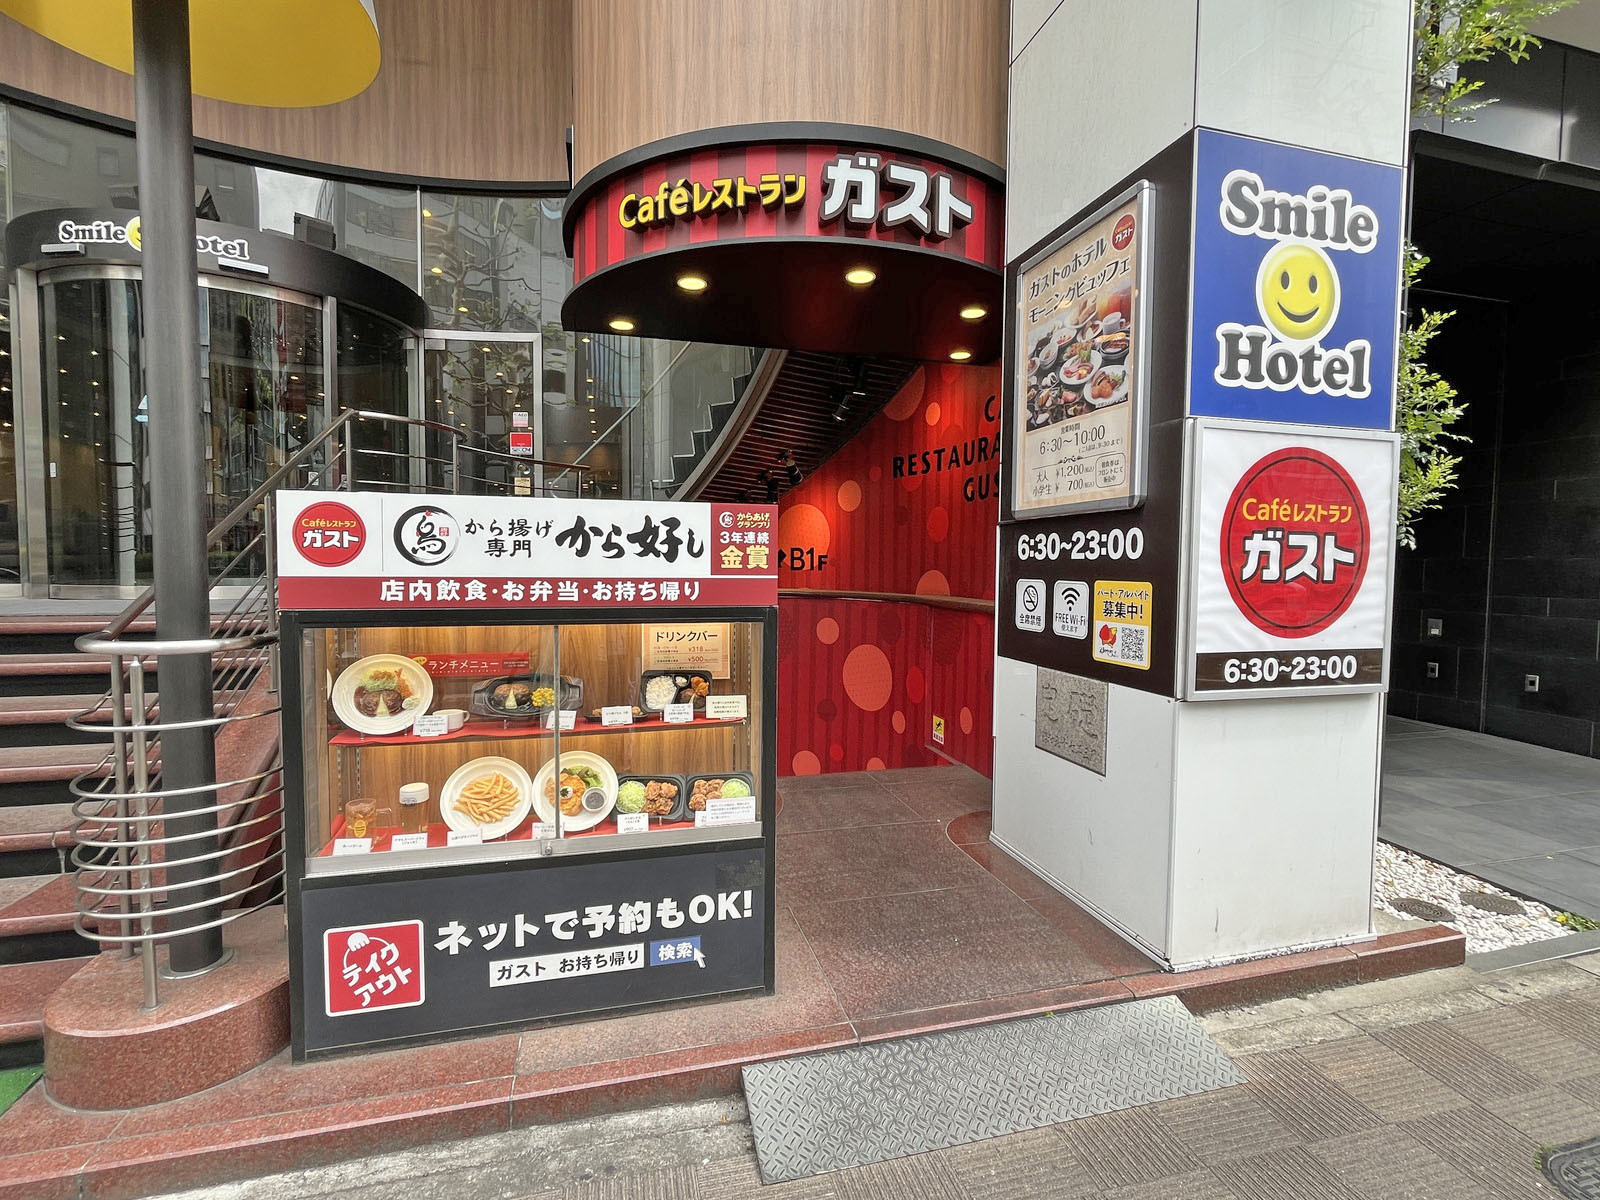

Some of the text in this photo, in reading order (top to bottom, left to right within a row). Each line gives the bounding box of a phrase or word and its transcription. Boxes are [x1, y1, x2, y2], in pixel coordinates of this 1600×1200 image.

[619, 153, 974, 236] Caféレストラン ガスト
[1222, 173, 1376, 250] Smile
[60, 221, 249, 259] Smile otel
[1114, 227, 1133, 243] ガスト
[1029, 238, 1108, 300] ガストのホテル
[1029, 257, 1130, 323] モーニングビュッフェ
[1217, 326, 1369, 396] Hotel
[1037, 471, 1048, 483] 大人
[1033, 483, 1052, 496] 小学生
[737, 512, 770, 522] からあげ
[1242, 498, 1352, 523] Caféレストラン
[302, 518, 357, 528] Caféレストラン
[464, 518, 553, 537] から揚げ
[737, 520, 771, 529] グランプリ
[302, 530, 360, 548] ガスト
[484, 538, 531, 559] 専門
[555, 515, 704, 563] から好し
[720, 532, 769, 544] 3年連続
[1017, 527, 1144, 560] 6:30~23:00
[720, 545, 770, 569] 金賞
[790, 548, 828, 571] B1F
[1240, 528, 1356, 584] ガスト
[380, 578, 700, 602] 店内飲食・お弁当・お持ち帰り
[1055, 612, 1086, 627] FREE Wi-Fi
[655, 630, 718, 643] ドリンクバー
[428, 659, 499, 669] ランチメニュー
[1224, 655, 1357, 683] 6:30~23:00
[434, 889, 753, 956] ネットで予約もOK!
[658, 941, 693, 962] 検索
[342, 943, 399, 987] テイク
[497, 949, 640, 981] ガスト お持ち帰り
[353, 965, 413, 1007] アウト
